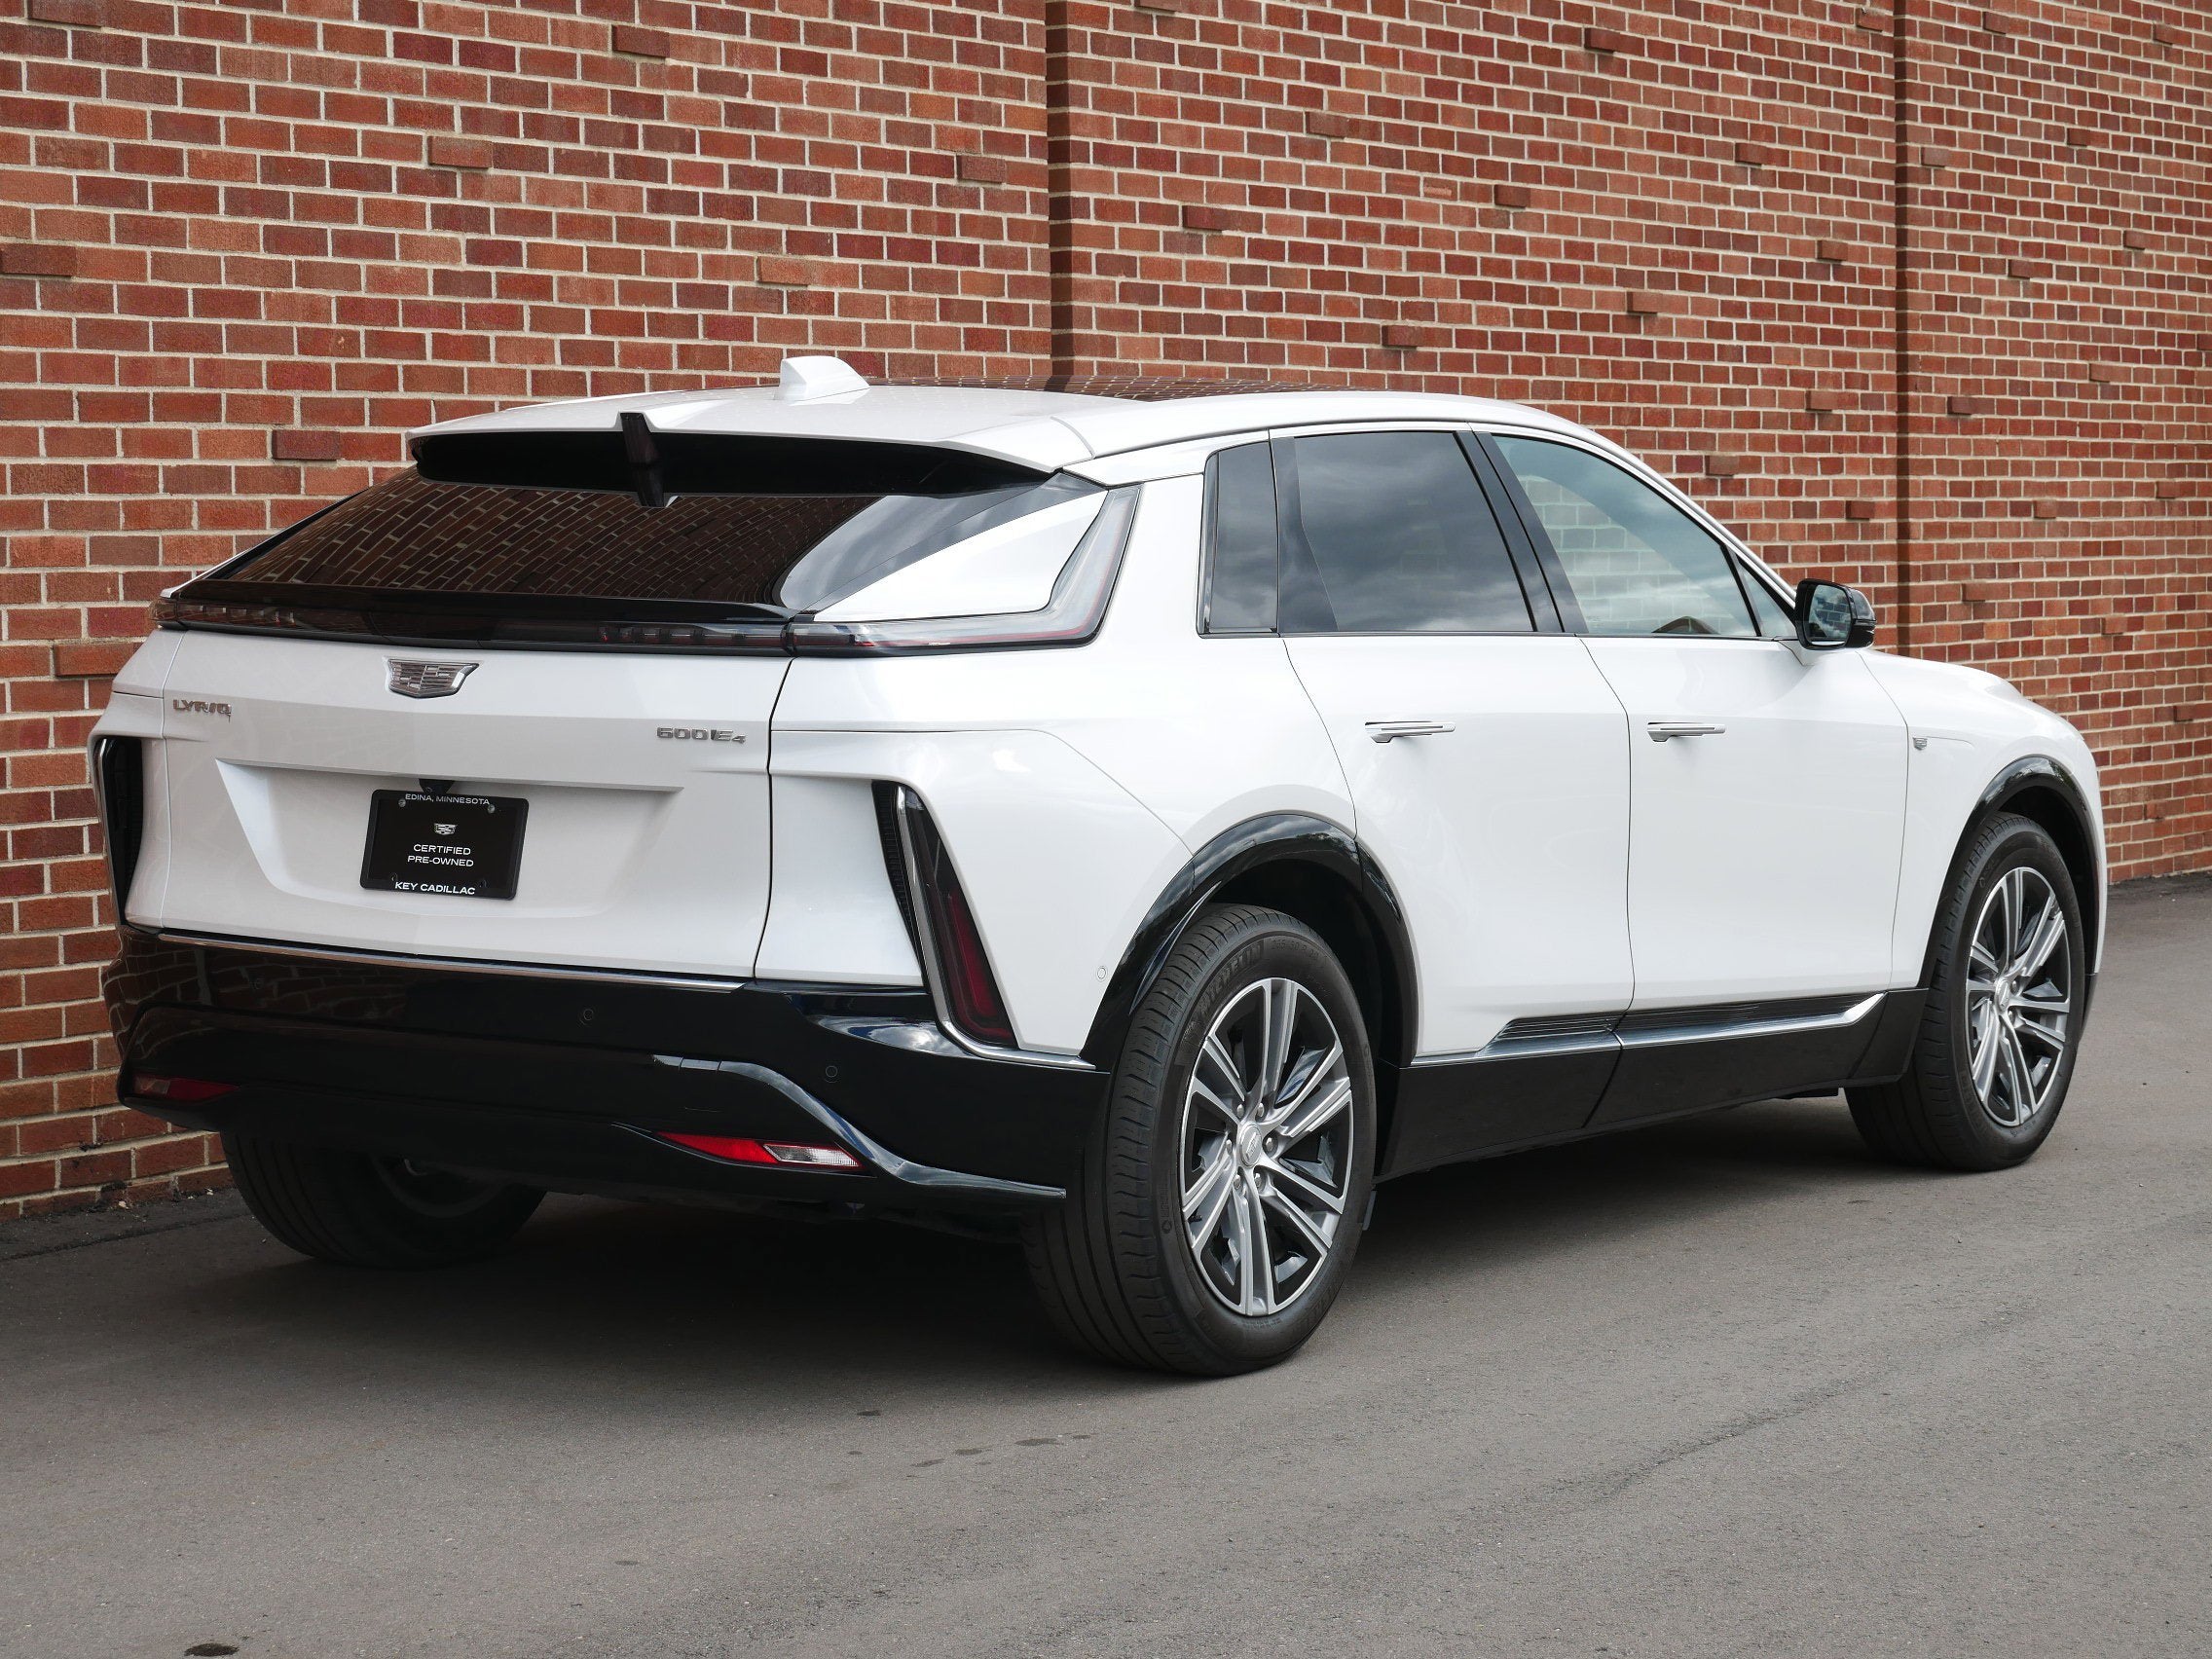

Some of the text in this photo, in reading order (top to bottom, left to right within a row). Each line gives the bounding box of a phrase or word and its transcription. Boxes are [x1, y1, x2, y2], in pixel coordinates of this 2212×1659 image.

[405, 793, 491, 806] EDINA, MINNESOTA
[413, 843, 471, 856] CERTIFIED
[407, 855, 474, 867] PRE-OWNED
[394, 881, 476, 895] KEY CADILLAC
